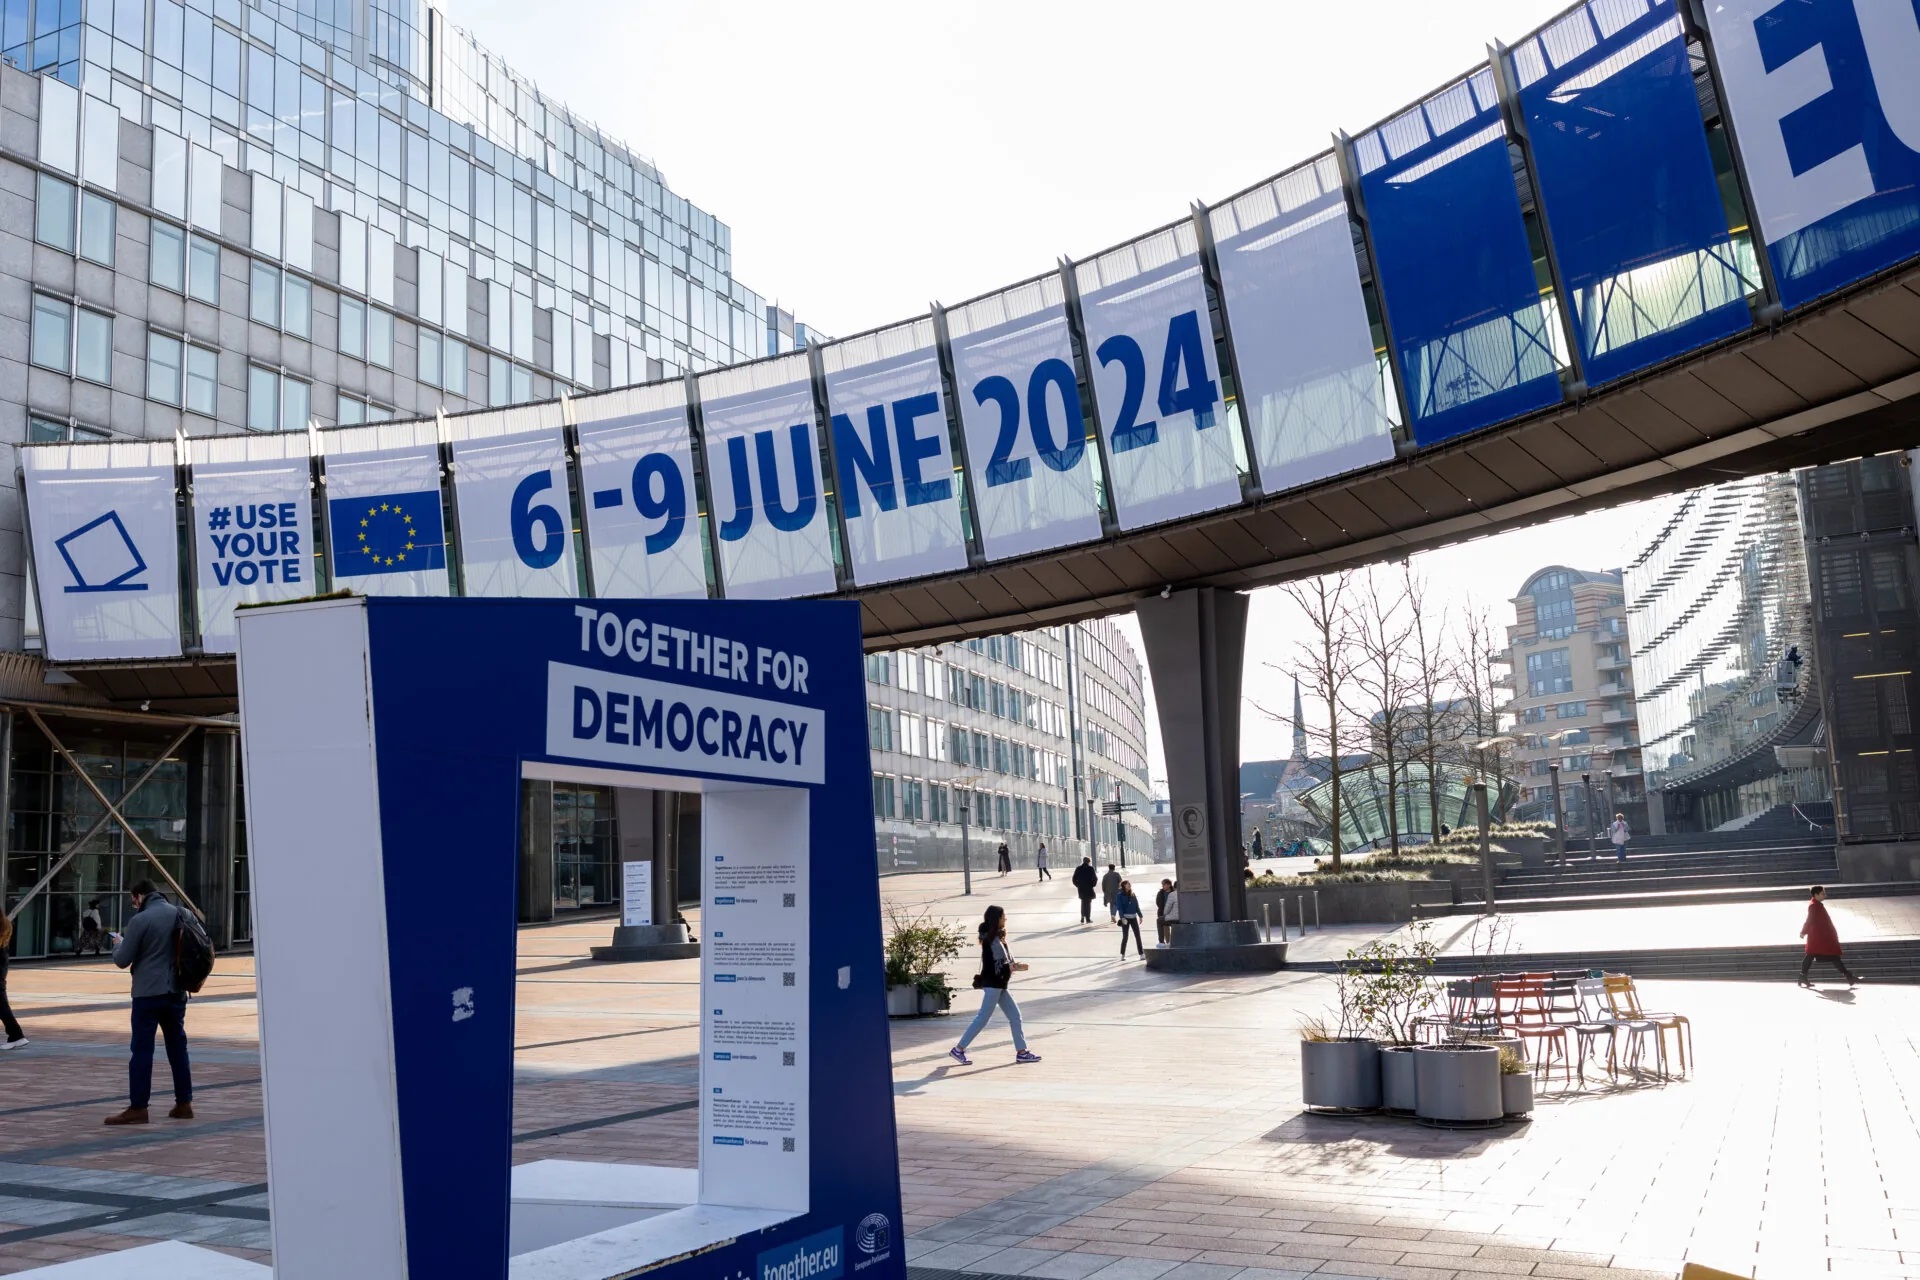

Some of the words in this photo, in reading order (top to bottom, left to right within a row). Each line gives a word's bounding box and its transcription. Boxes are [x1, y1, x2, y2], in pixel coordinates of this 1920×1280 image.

[719, 391, 954, 542] JUNE
[972, 309, 1219, 489] 2024
[209, 502, 297, 531] #USE
[210, 531, 301, 560] YOUR
[212, 558, 301, 586] VOTE
[574, 604, 749, 683] TOGETHER
[756, 646, 809, 695] FOR
[572, 684, 808, 766] DEMOCRACY
[763, 1244, 839, 1280] together.eu
[854, 1258, 871, 1272] European
